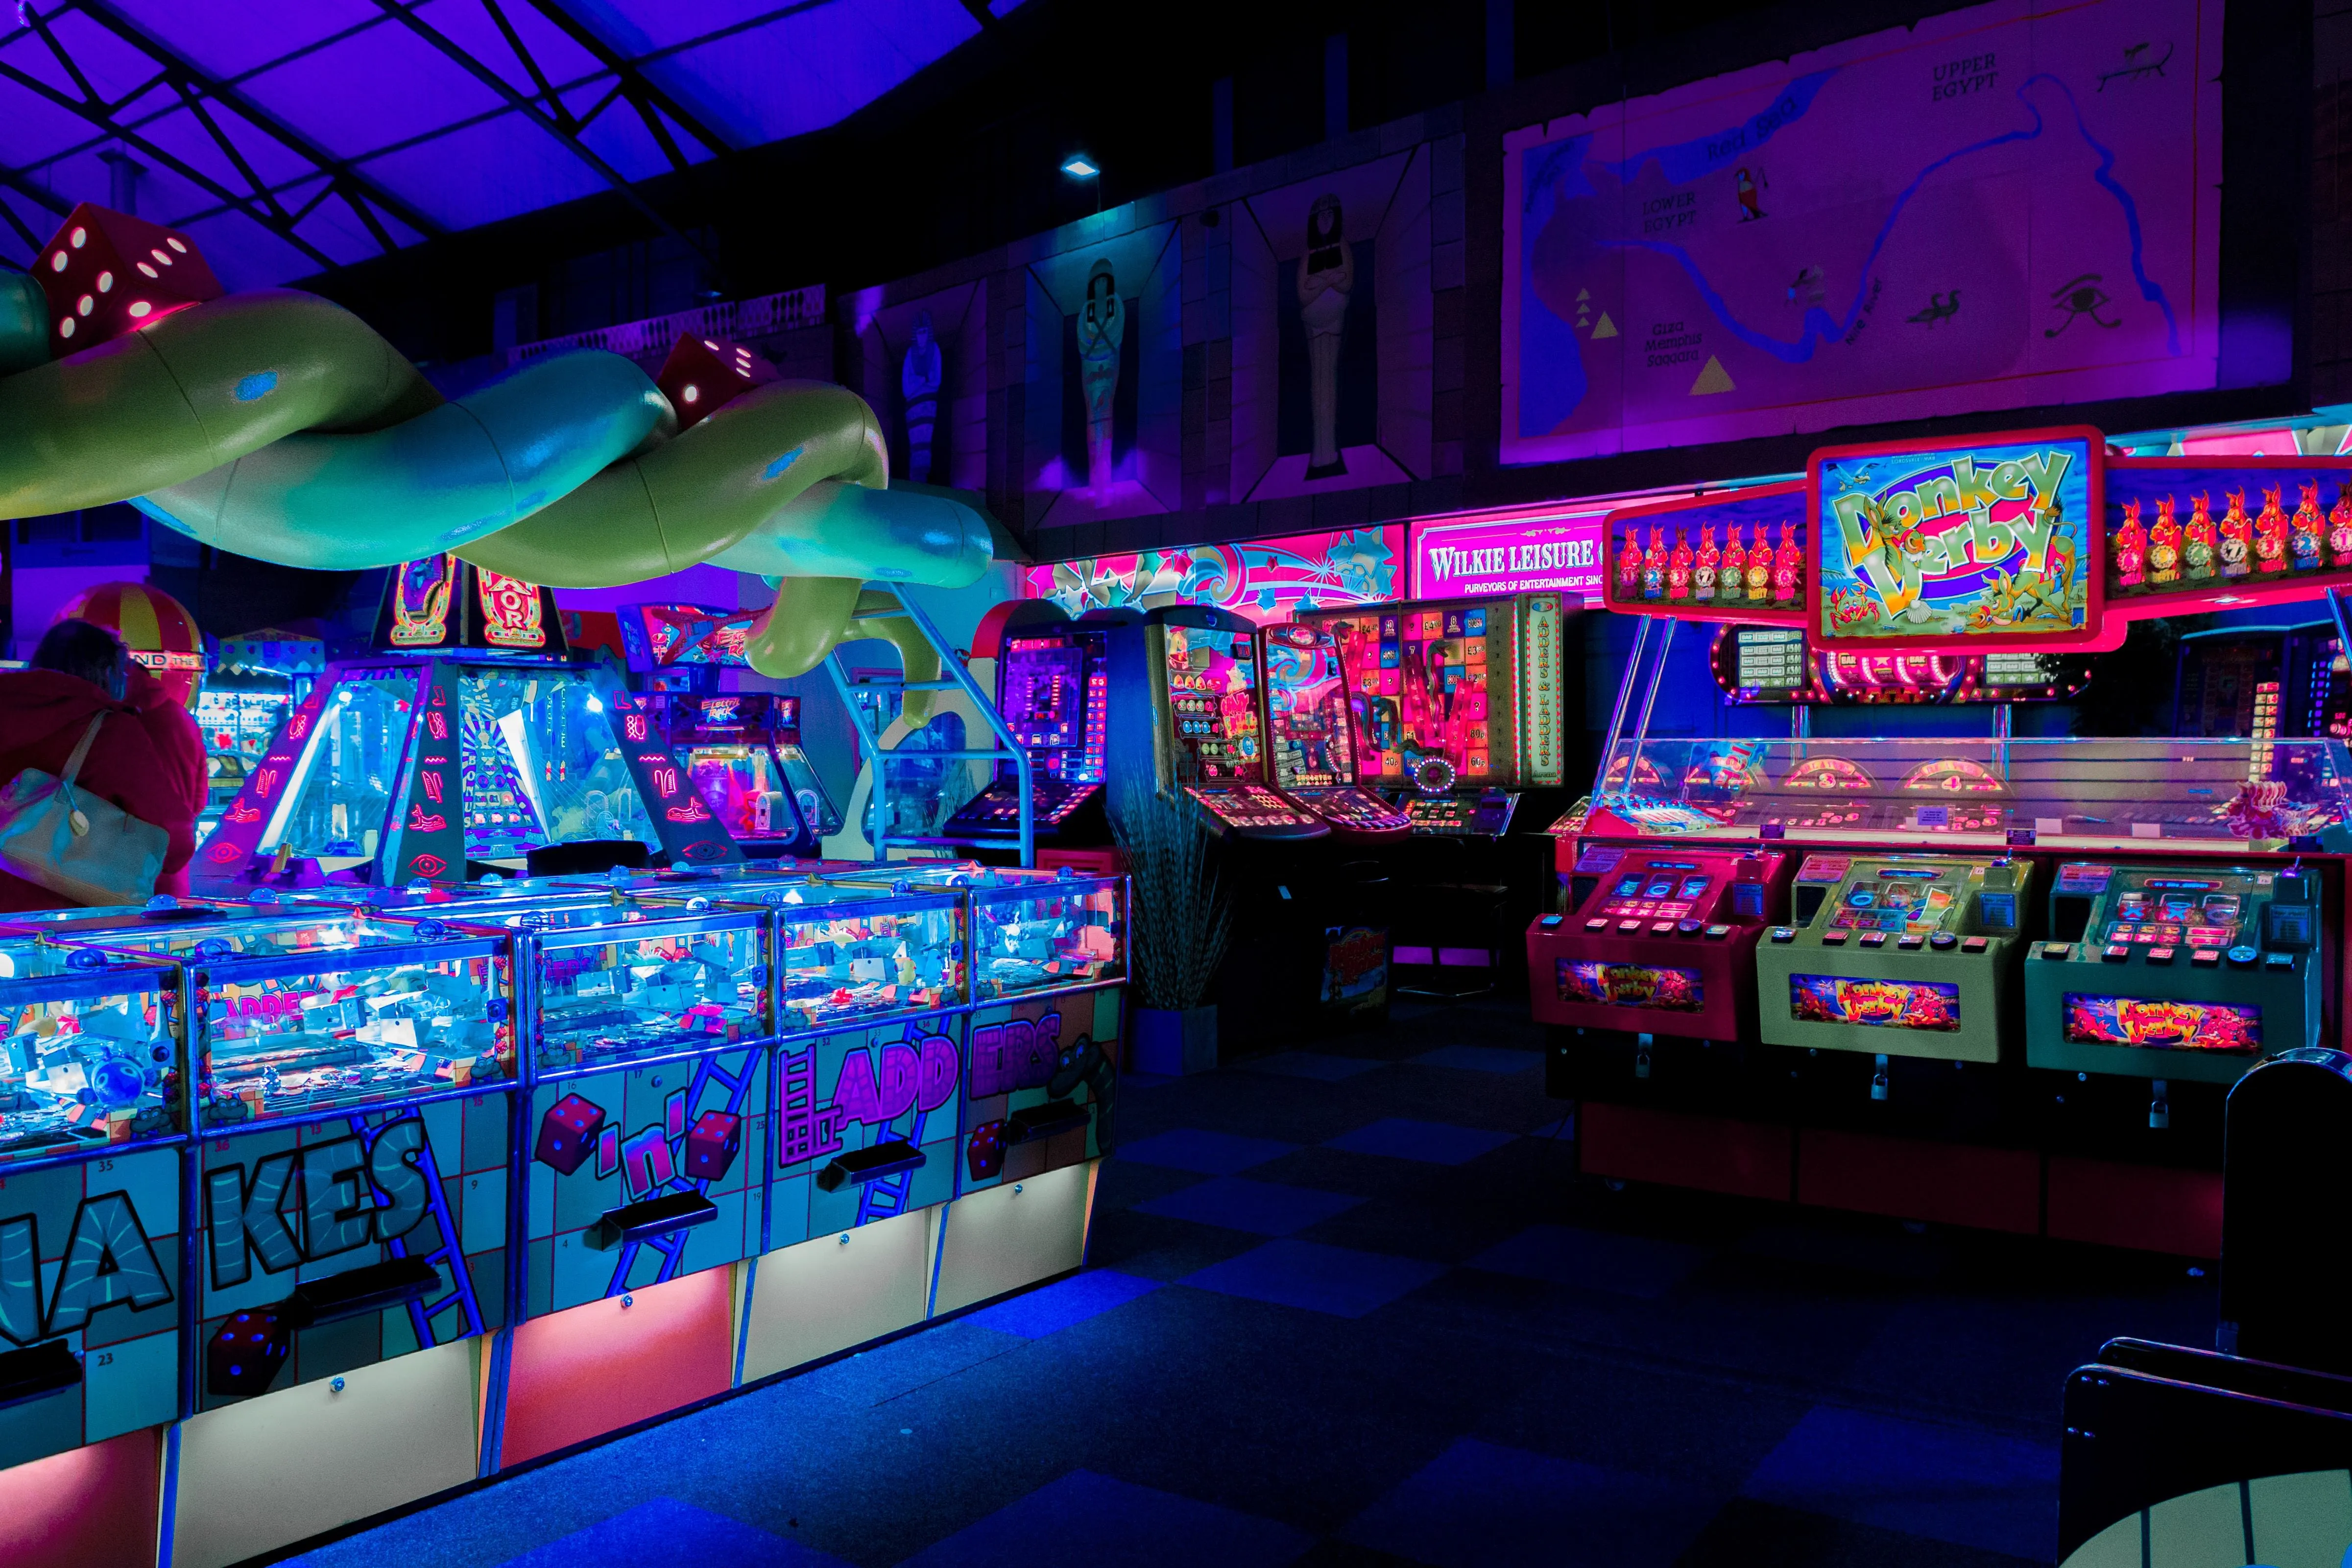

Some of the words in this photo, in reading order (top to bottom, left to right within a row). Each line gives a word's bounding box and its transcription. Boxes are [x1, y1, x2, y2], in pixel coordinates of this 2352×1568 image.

[1934, 52, 1995, 80] UPPER
[1934, 72, 1997, 100] EGYPT
[1642, 192, 1695, 215] LOWER
[1644, 211, 1696, 233] EGYPT
[1653, 321, 1683, 335] Giza
[1645, 333, 1702, 352] Memphis
[1647, 349, 1700, 367] Saqqara
[1831, 451, 2072, 566] Donkey
[2228, 543, 2240, 557] 7
[2265, 541, 2275, 553] 3
[2302, 537, 2312, 550] 2
[2340, 532, 2348, 545] 1
[1429, 546, 1505, 581] WILKIE
[1508, 539, 1594, 573] LEISURE
[1862, 509, 2054, 621] Derby
[1464, 582, 1506, 594] PURVEYORS
[1508, 581, 1518, 590] OF
[1520, 576, 1584, 590] ENTERTAINMENT
[1650, 571, 1658, 582] 2
[1700, 571, 1711, 582] 7
[1537, 616, 1550, 678] ADDERS
[1841, 657, 1856, 665] BAR
[1538, 681, 1550, 691] &
[1470, 729, 1485, 739] 80p
[1539, 694, 1551, 766] LADDERS
[1385, 757, 1398, 766] 40p
[1471, 757, 1485, 767] 60p
[1820, 774, 1835, 788] 3
[1943, 776, 1959, 791] 4
[1836, 980, 1910, 1003] Donkey
[1843, 996, 1905, 1023] Derby
[2117, 999, 2206, 1026] Donkey
[2128, 1012, 2199, 1044] Derby
[822, 1037, 831, 1046] 32
[567, 1081, 576, 1090] 16
[215, 1139, 230, 1153] 36
[98, 1159, 114, 1173] 35
[471, 1180, 478, 1190] 9
[753, 1193, 761, 1202] 19
[562, 1239, 568, 1248] 4
[98, 1353, 113, 1367] 23
